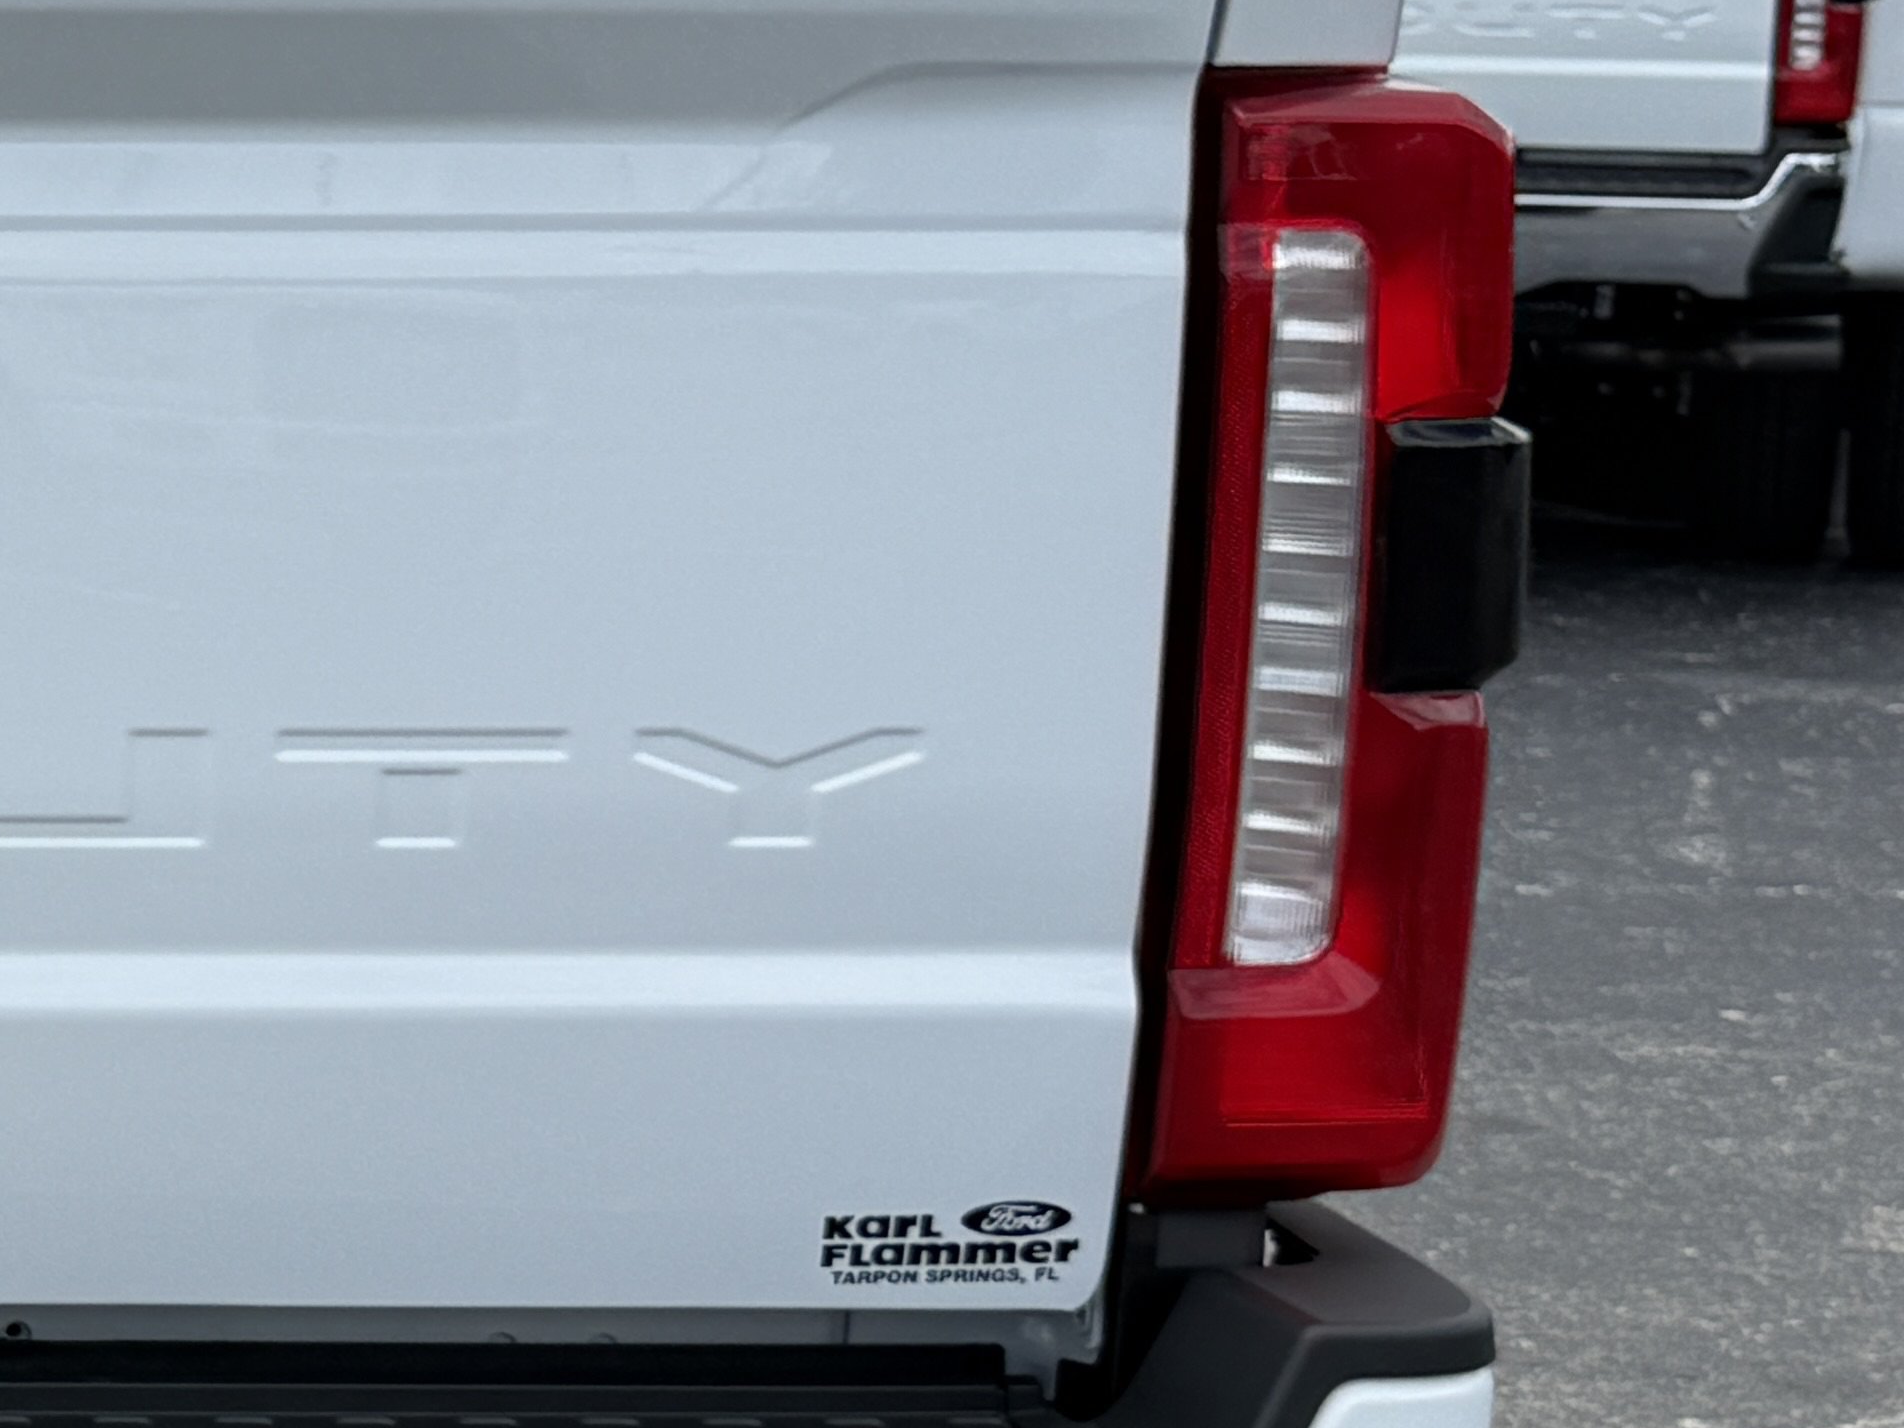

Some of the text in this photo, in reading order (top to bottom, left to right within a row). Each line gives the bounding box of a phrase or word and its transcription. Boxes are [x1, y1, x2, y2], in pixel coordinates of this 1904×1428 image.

[830, 1266, 1060, 1285] TARPON SPRINGS, FL
